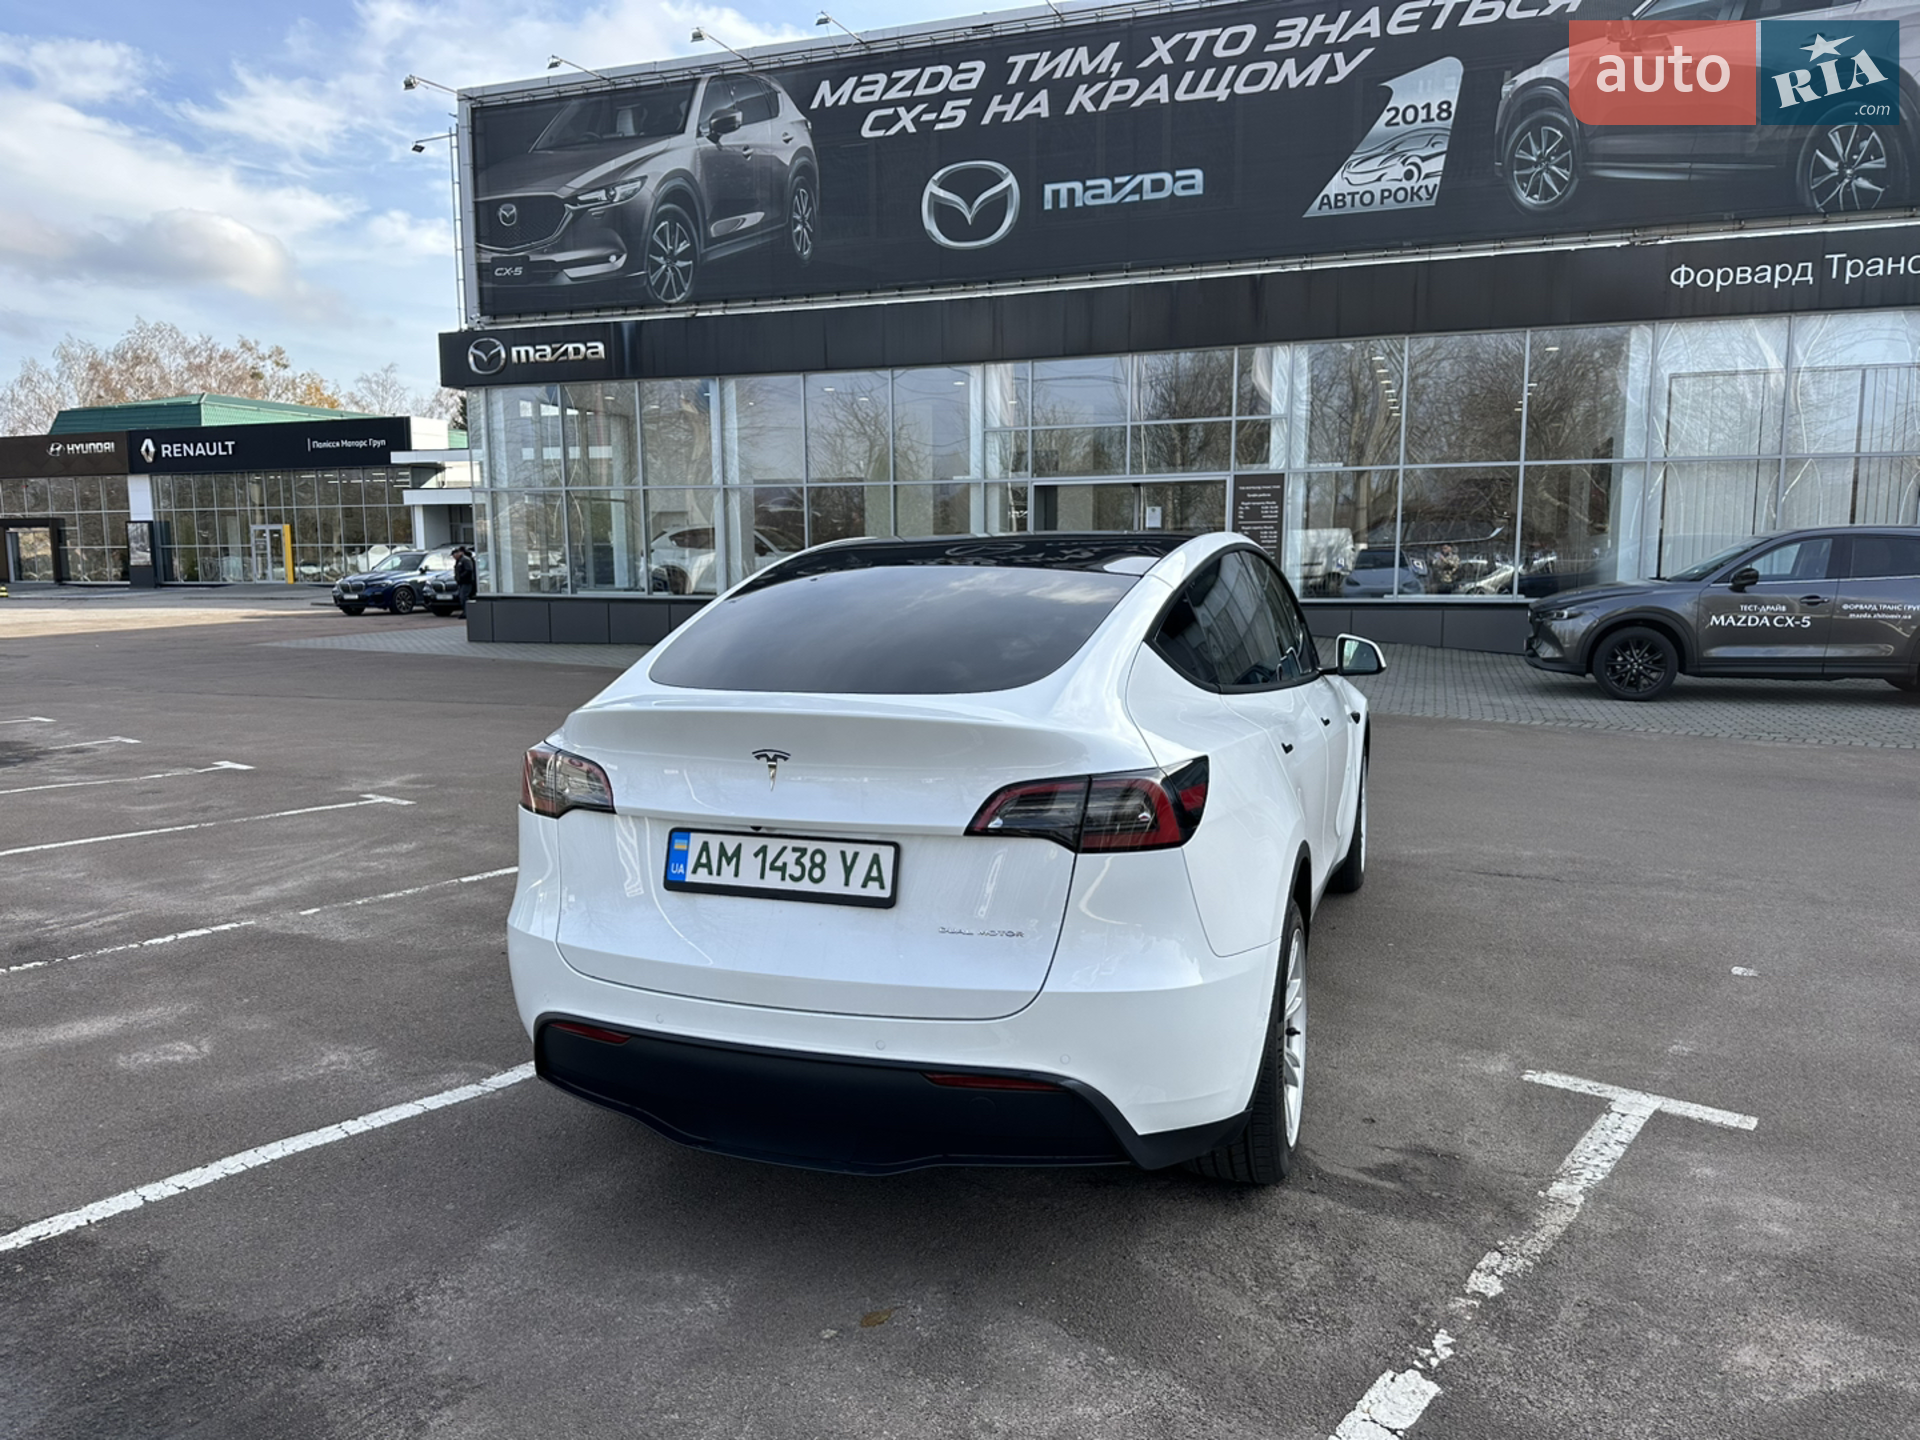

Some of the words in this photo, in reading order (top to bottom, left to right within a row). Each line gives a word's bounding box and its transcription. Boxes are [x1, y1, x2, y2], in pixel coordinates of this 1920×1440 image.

[1006, 42, 1122, 85] ТИМ,
[1136, 24, 1257, 68] ХТО
[860, 98, 973, 138] CX-5
[980, 89, 1050, 125] НА
[1064, 47, 1376, 115] КРАЩОМУ
[1384, 100, 1453, 127] 2018
[1043, 167, 1204, 210] mazda
[1317, 190, 1375, 211] АВТО
[1380, 183, 1438, 205] РОКУ
[494, 266, 523, 277] CX-5
[1669, 261, 1815, 292] Форвард
[1824, 253, 1920, 285] Транс
[511, 341, 606, 364] mazda
[66, 442, 116, 455] HYUNDAI
[161, 441, 236, 458] RENAULT
[1740, 604, 1787, 613] ТЕСТ-ДРАЙВ
[1710, 615, 1771, 628] MAZDA
[1772, 615, 1812, 629] CX-5
[670, 863, 685, 875] UA
[691, 840, 742, 878] AM
[753, 844, 828, 884] 1438
[839, 850, 886, 890] YA
[939, 926, 975, 936] DUAL
[977, 930, 1025, 938] MOTOR
